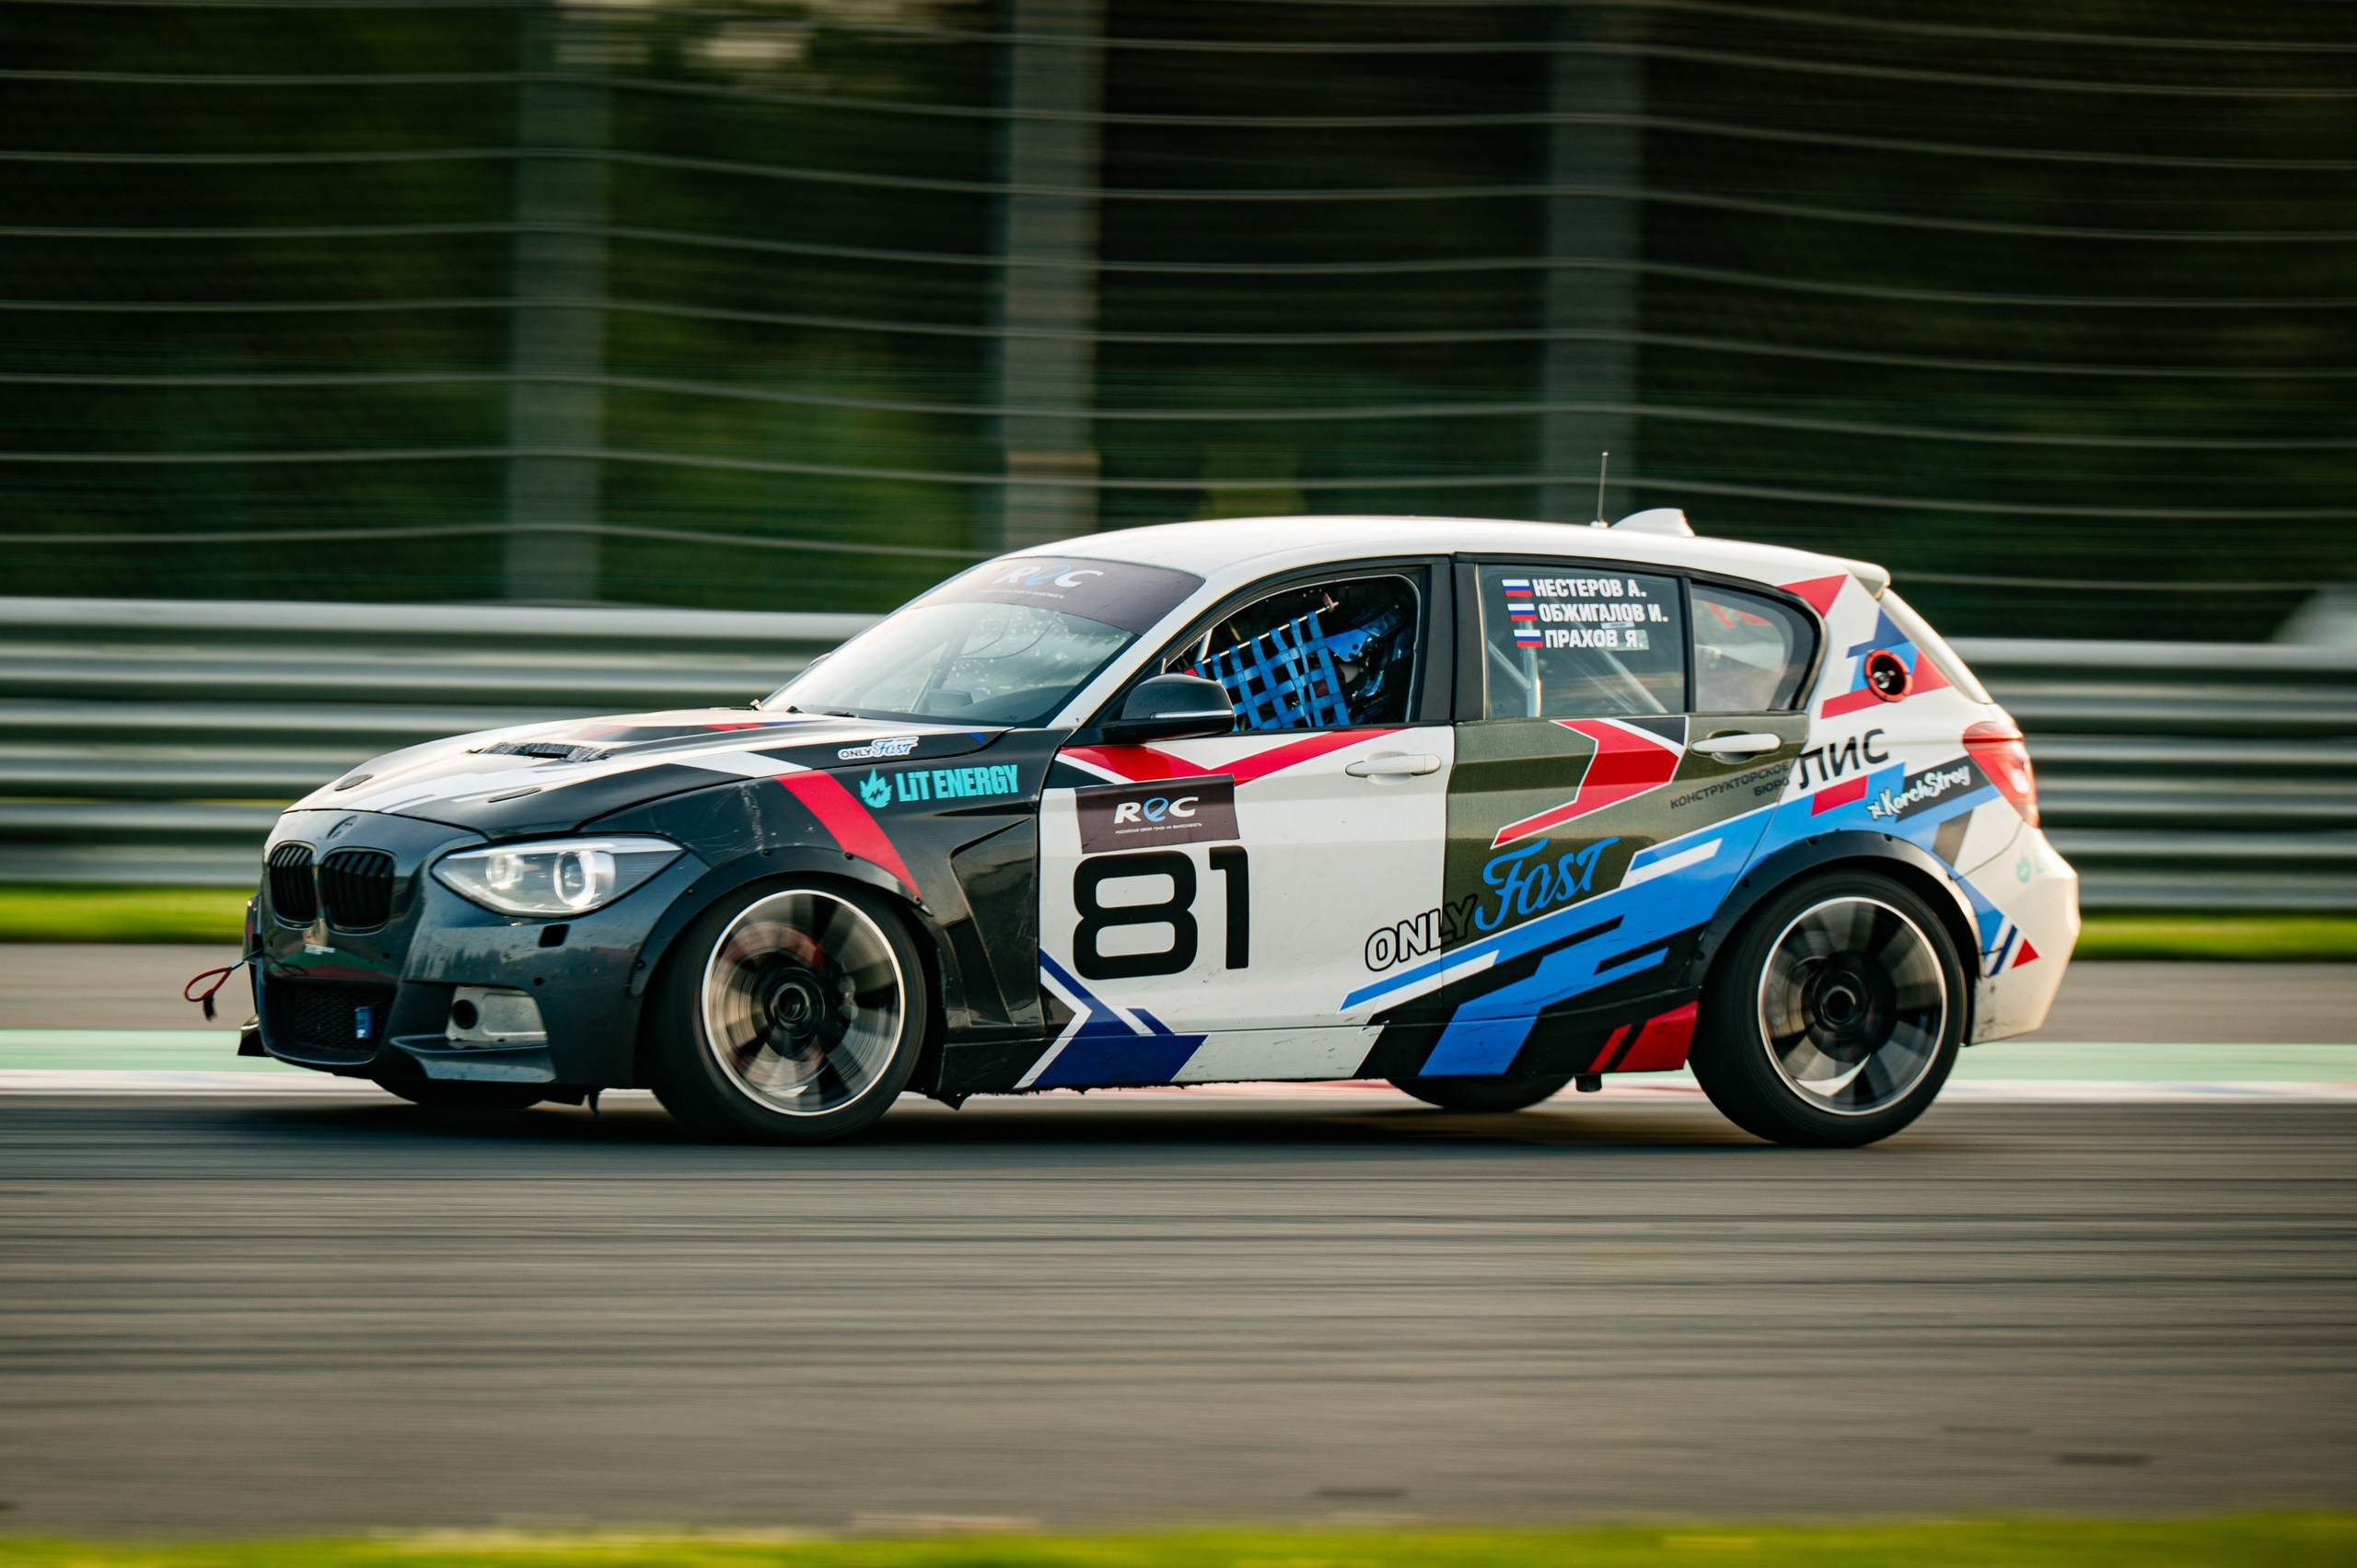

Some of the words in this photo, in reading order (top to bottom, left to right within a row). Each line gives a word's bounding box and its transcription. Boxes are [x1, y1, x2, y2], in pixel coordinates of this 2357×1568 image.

[1532, 578, 1624, 598] НЕСТЕРОВ
[1628, 578, 1647, 598] А.
[1538, 603, 1646, 622] ОБЖИГАЛОВ
[1647, 604, 1669, 622] И.
[1544, 629, 1619, 648] ПРАХОВ
[1624, 629, 1644, 648] Я.
[1797, 728, 1889, 789] ЛИС
[932, 764, 1019, 800] ENERGY
[1669, 761, 1790, 809] КОНСТРУКТОРСКОЕ
[1753, 777, 1790, 796] БЮРО
[1073, 844, 1250, 981] 81
